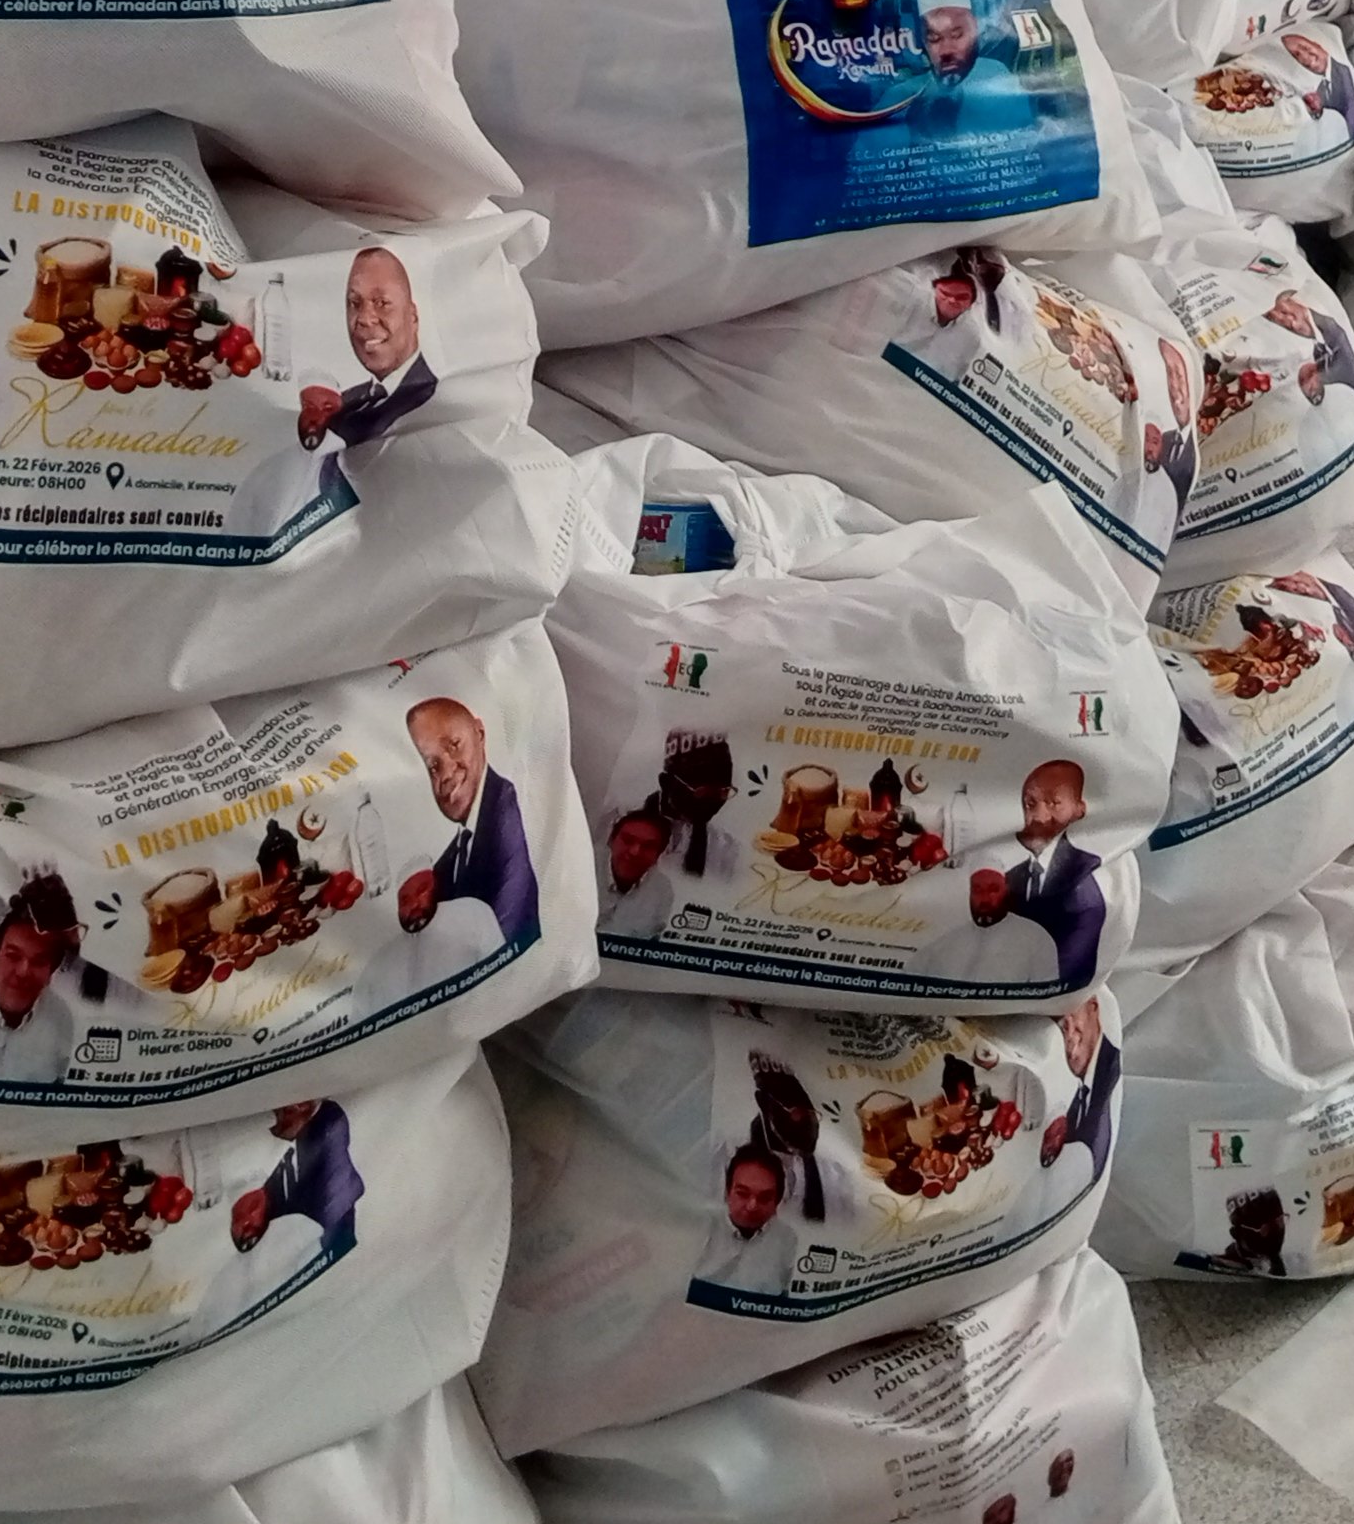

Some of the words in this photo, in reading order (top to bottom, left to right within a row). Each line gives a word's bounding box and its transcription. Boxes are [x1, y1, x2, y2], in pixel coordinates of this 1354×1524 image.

[783, 22, 924, 67] Ramadan
[27, 167, 40, 179] la
[45, 173, 130, 194] Génération
[70, 167, 107, 182] avec
[127, 175, 194, 215] sponsoring
[13, 189, 41, 213] LA
[0, 378, 249, 452] Ramadan
[13, 457, 29, 470] 22
[38, 477, 85, 490] 08H00
[15, 504, 124, 525] récipiendaires
[166, 510, 224, 527] conviés
[25, 541, 94, 555] célébrer
[113, 541, 192, 556] Ramadan
[782, 662, 810, 677] Sous
[813, 667, 824, 679] le
[827, 671, 891, 692] parrainage
[910, 684, 953, 700] Ministre
[97, 814, 113, 828] la
[116, 786, 200, 820] Génération
[103, 843, 131, 869] LA
[374, 1000, 429, 1032] partage
[138, 1038, 185, 1056] Heure:
[187, 1036, 233, 1052] 08H00
